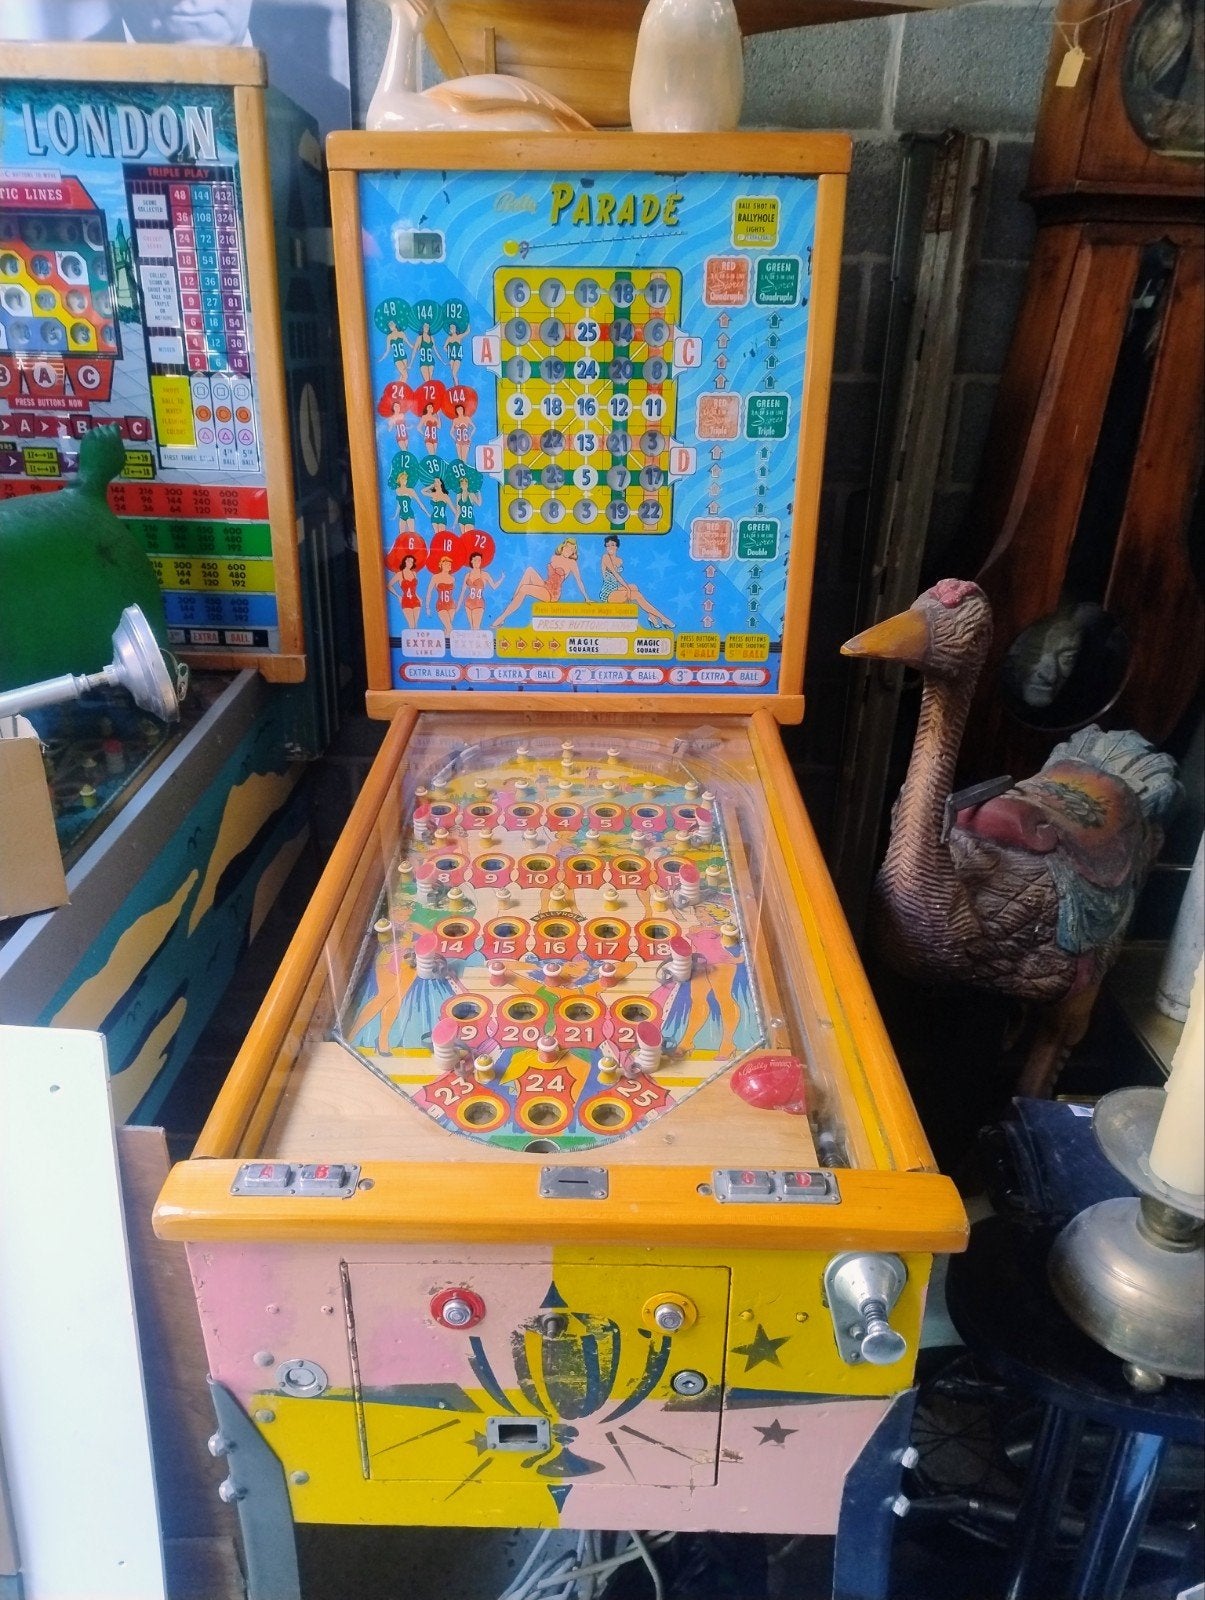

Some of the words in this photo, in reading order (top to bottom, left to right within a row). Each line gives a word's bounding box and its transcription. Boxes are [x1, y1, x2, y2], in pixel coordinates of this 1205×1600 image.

[22, 103, 219, 160] LONDON
[147, 167, 180, 177] TRIPLE
[184, 168, 209, 178] PLAY
[24, 188, 63, 201] LINES
[174, 190, 186, 200] 48
[194, 191, 209, 200] 144
[215, 191, 231, 200] 432
[550, 181, 686, 226] PARADE
[176, 212, 188, 222] 36
[196, 213, 211, 222] 108
[217, 214, 233, 223] 324
[738, 213, 775, 223] BALLYHOLE
[179, 235, 190, 243] 24
[200, 235, 212, 244] 72
[220, 235, 235, 244] 216
[182, 255, 192, 265] 18
[202, 256, 214, 265] 54
[221, 256, 237, 265] 162
[722, 261, 736, 271] RED
[766, 262, 791, 272] GREEN
[184, 277, 195, 286] 12
[204, 277, 216, 286] 36
[223, 278, 239, 287] 108
[514, 283, 525, 302] 6
[550, 284, 560, 302] 7
[580, 284, 598, 302] 13
[615, 283, 634, 302] 18
[650, 284, 668, 302] 17
[710, 291, 744, 303] Quadruple
[759, 291, 793, 303] Quadruple
[189, 298, 195, 307] 9
[206, 298, 218, 307] 27
[228, 299, 238, 307] 81
[383, 301, 397, 316] 48
[417, 305, 433, 319] 144
[447, 304, 462, 318] 192
[515, 321, 527, 339] 9
[547, 319, 560, 341] 4
[578, 318, 597, 342] 25
[614, 318, 632, 342] 14
[652, 321, 663, 339] 6
[392, 343, 405, 357] 36
[420, 348, 433, 362] 96
[447, 346, 463, 359] 144
[480, 337, 493, 363] A
[682, 338, 695, 365] C
[39, 367, 52, 383] A
[83, 368, 96, 385] C
[516, 360, 524, 379] 1
[545, 360, 563, 379] 19
[576, 360, 598, 379] 24
[612, 360, 633, 379] 20
[651, 361, 662, 380] 8
[392, 385, 404, 399] 24
[424, 386, 436, 400] 72
[449, 389, 466, 404] 144
[15, 398, 35, 407] PRESS
[38, 398, 66, 407] BUTTONS
[69, 399, 83, 408] NOW
[513, 398, 524, 416] 2
[544, 398, 562, 416] 18
[577, 398, 596, 416] 16
[610, 398, 629, 417] 12
[645, 399, 662, 416] 11
[713, 399, 727, 407] RED
[756, 399, 780, 408] GREEN
[20, 419, 31, 432] A
[76, 420, 88, 434] B
[132, 421, 143, 435] C
[758, 426, 775, 436] Triple
[396, 424, 406, 438] 18
[425, 426, 437, 440] 48
[456, 428, 468, 441] 96
[510, 434, 530, 451] 10
[543, 431, 563, 448] 22
[576, 434, 595, 451] 13
[610, 434, 628, 452] 21
[647, 430, 658, 450] 3
[483, 446, 495, 470] B
[677, 449, 690, 472] D
[401, 455, 410, 468] 12
[426, 459, 440, 474] 36
[452, 464, 466, 478] 96
[516, 470, 532, 487] 15
[582, 469, 591, 486] 5
[617, 470, 627, 487] 7
[645, 465, 661, 481] 17
[402, 500, 408, 513] 8
[433, 506, 445, 518] 24
[461, 506, 473, 519] 96
[518, 502, 527, 519] 5
[548, 502, 559, 518] 8
[582, 503, 592, 519] 3
[610, 503, 628, 519] 19
[641, 503, 660, 519] 22
[747, 523, 771, 531] GREEN
[408, 537, 414, 550] 6
[443, 539, 452, 551] 18
[475, 535, 487, 549] 72
[747, 547, 768, 556] Double
[201, 562, 218, 570] 450
[228, 563, 246, 571] 600
[406, 587, 412, 599] 4
[441, 590, 449, 602] 16
[470, 587, 482, 600] 64
[193, 632, 217, 640] EXTRA
[230, 633, 249, 642] BALL
[406, 639, 442, 648] EXTRA
[568, 638, 600, 646] MAGIC
[729, 635, 744, 643] PRESS
[408, 668, 432, 677] EXTRA
[435, 668, 457, 678] BALLS
[498, 669, 523, 679] EXTRA
[537, 669, 555, 679] BALL
[598, 670, 624, 681] EXTRA
[638, 671, 657, 681] BALL
[701, 672, 726, 681] EXTRA
[740, 672, 758, 681] BALL
[473, 818, 486, 827] 2
[516, 818, 528, 827] 3
[558, 819, 570, 828] 4
[600, 819, 612, 828] 5
[641, 820, 654, 828] 6
[438, 873, 450, 883] 8
[485, 873, 498, 884] 9
[526, 873, 549, 884] 10
[575, 874, 593, 885] 11
[619, 874, 642, 886] 12
[533, 911, 584, 922] BALLYHOLE
[440, 940, 464, 953] 14
[492, 941, 516, 954] 15
[543, 941, 566, 954] 16
[594, 942, 619, 955] 17
[646, 943, 671, 956] 18
[501, 1026, 540, 1042] 20
[564, 1027, 594, 1043] 21
[525, 1074, 565, 1093] 24
[434, 1076, 474, 1106] 23
[616, 1079, 660, 1107] 25
